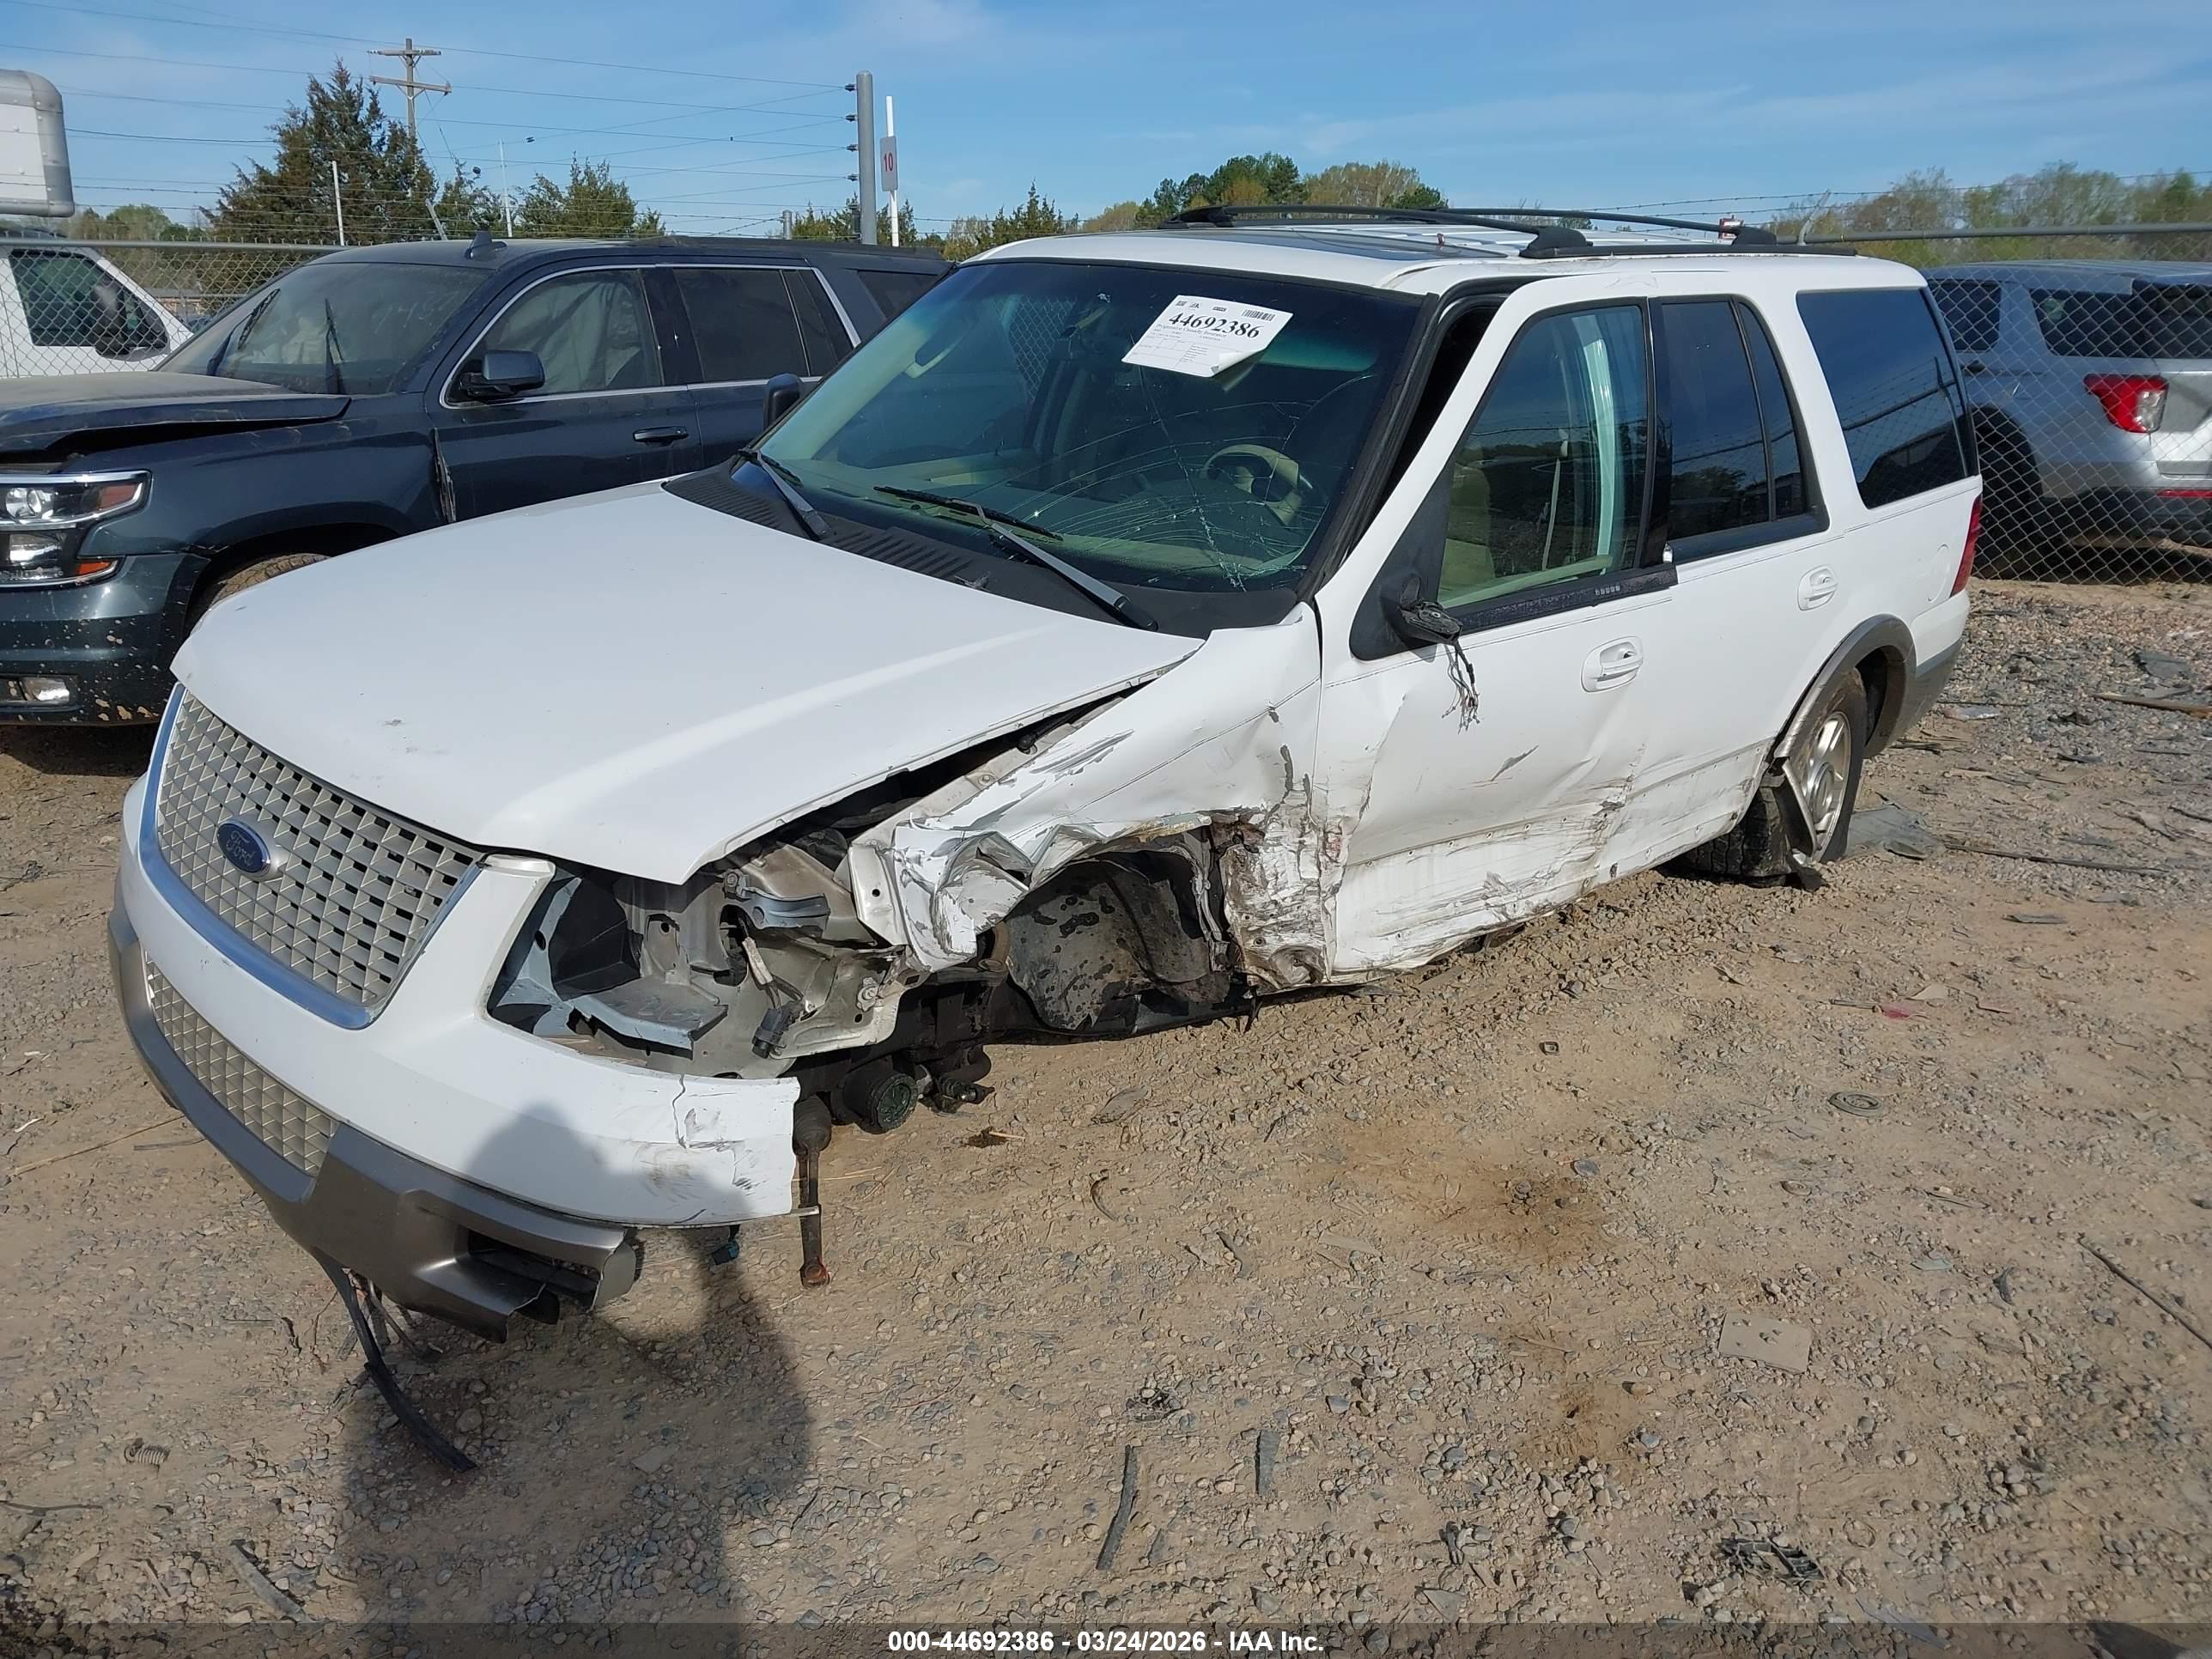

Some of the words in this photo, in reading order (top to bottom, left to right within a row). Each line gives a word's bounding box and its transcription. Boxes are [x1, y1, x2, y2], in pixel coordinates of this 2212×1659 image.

[884, 151, 894, 172] 10
[1169, 313, 1265, 338] 44692386
[225, 830, 257, 866] Ford
